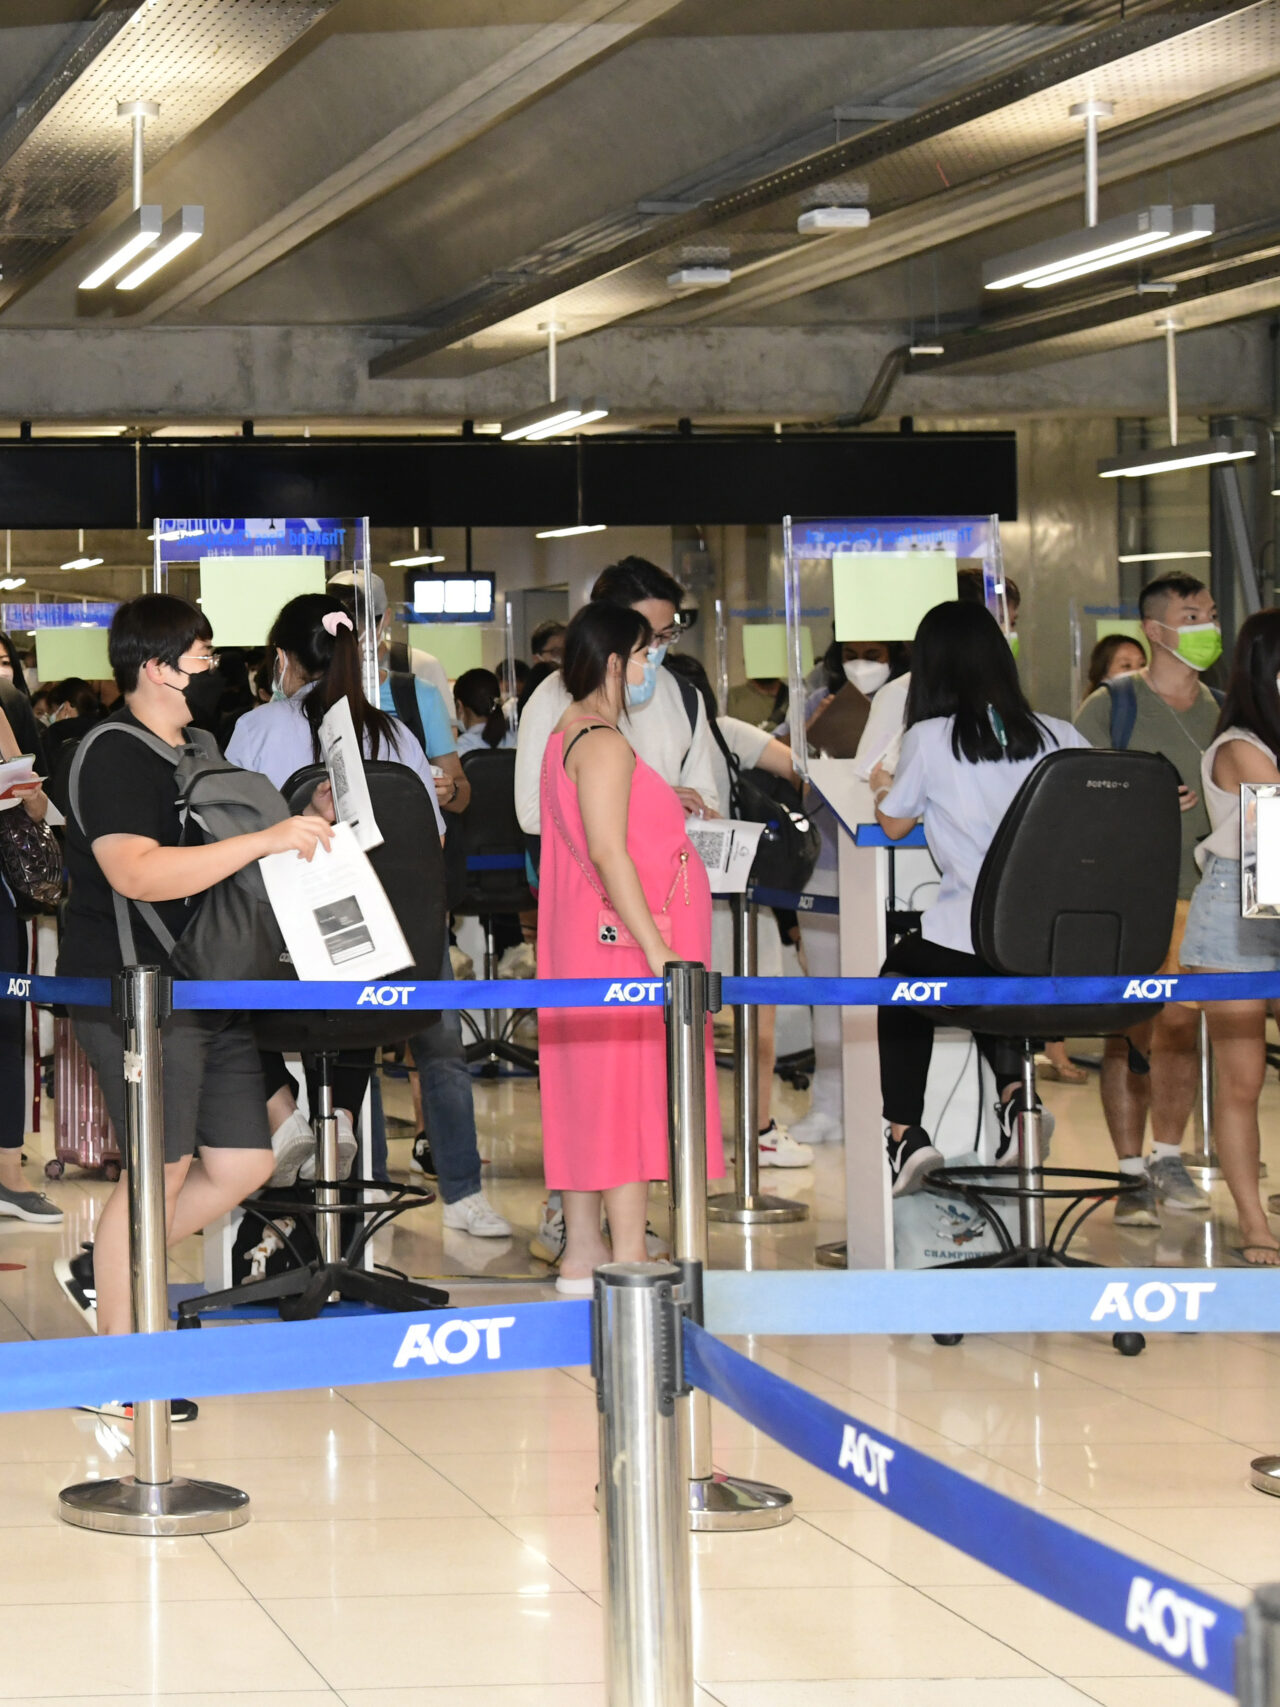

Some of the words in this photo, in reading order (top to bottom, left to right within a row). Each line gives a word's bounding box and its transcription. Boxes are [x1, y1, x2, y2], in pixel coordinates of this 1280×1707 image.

[6, 977, 32, 998] AOT
[356, 985, 416, 1006] AOT
[603, 982, 663, 1003] AOT
[890, 981, 949, 1003] AOT
[1121, 978, 1180, 999] AOT
[1090, 1281, 1217, 1322] AOT
[392, 1316, 516, 1368] AOT
[838, 1423, 895, 1495] AOT
[1125, 1576, 1218, 1668] AOT
